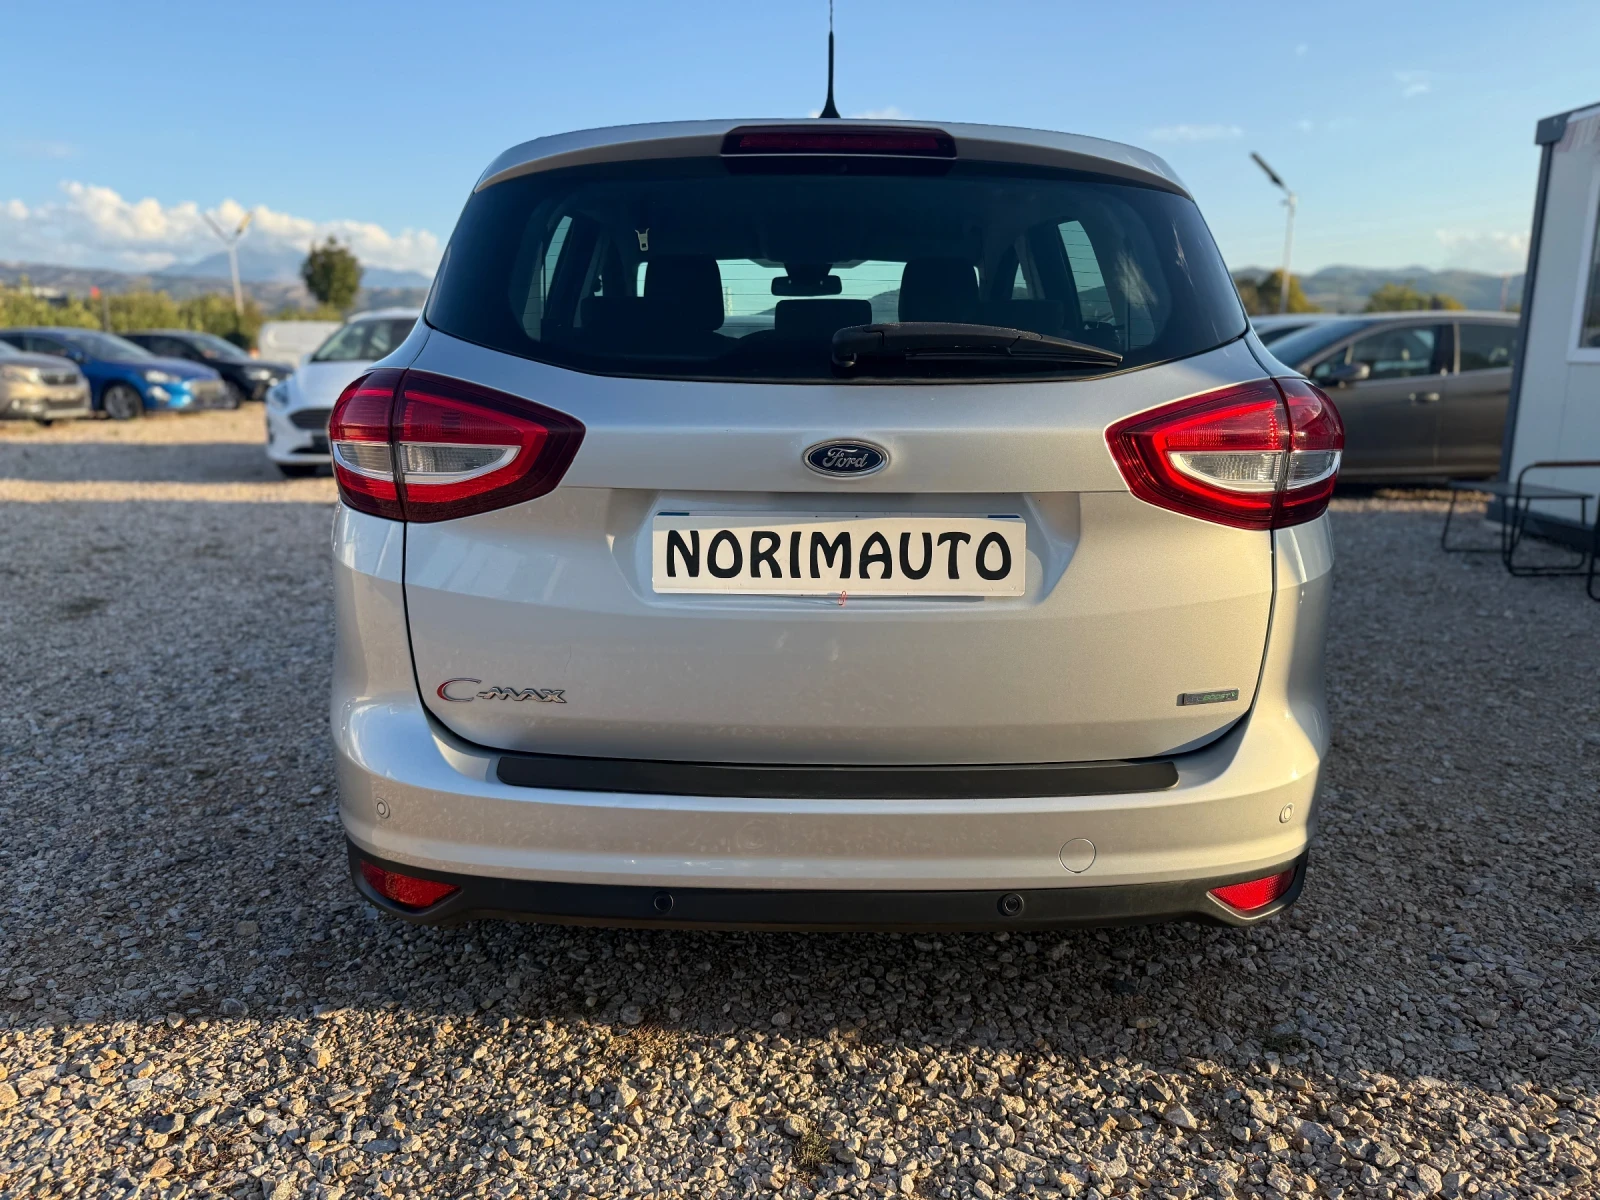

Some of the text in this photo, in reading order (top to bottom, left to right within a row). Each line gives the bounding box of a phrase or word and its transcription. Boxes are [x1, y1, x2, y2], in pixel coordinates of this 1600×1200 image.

[822, 447, 869, 468] Ford
[666, 529, 1012, 580] NORIMAUTO
[436, 677, 567, 704] C-MAX
